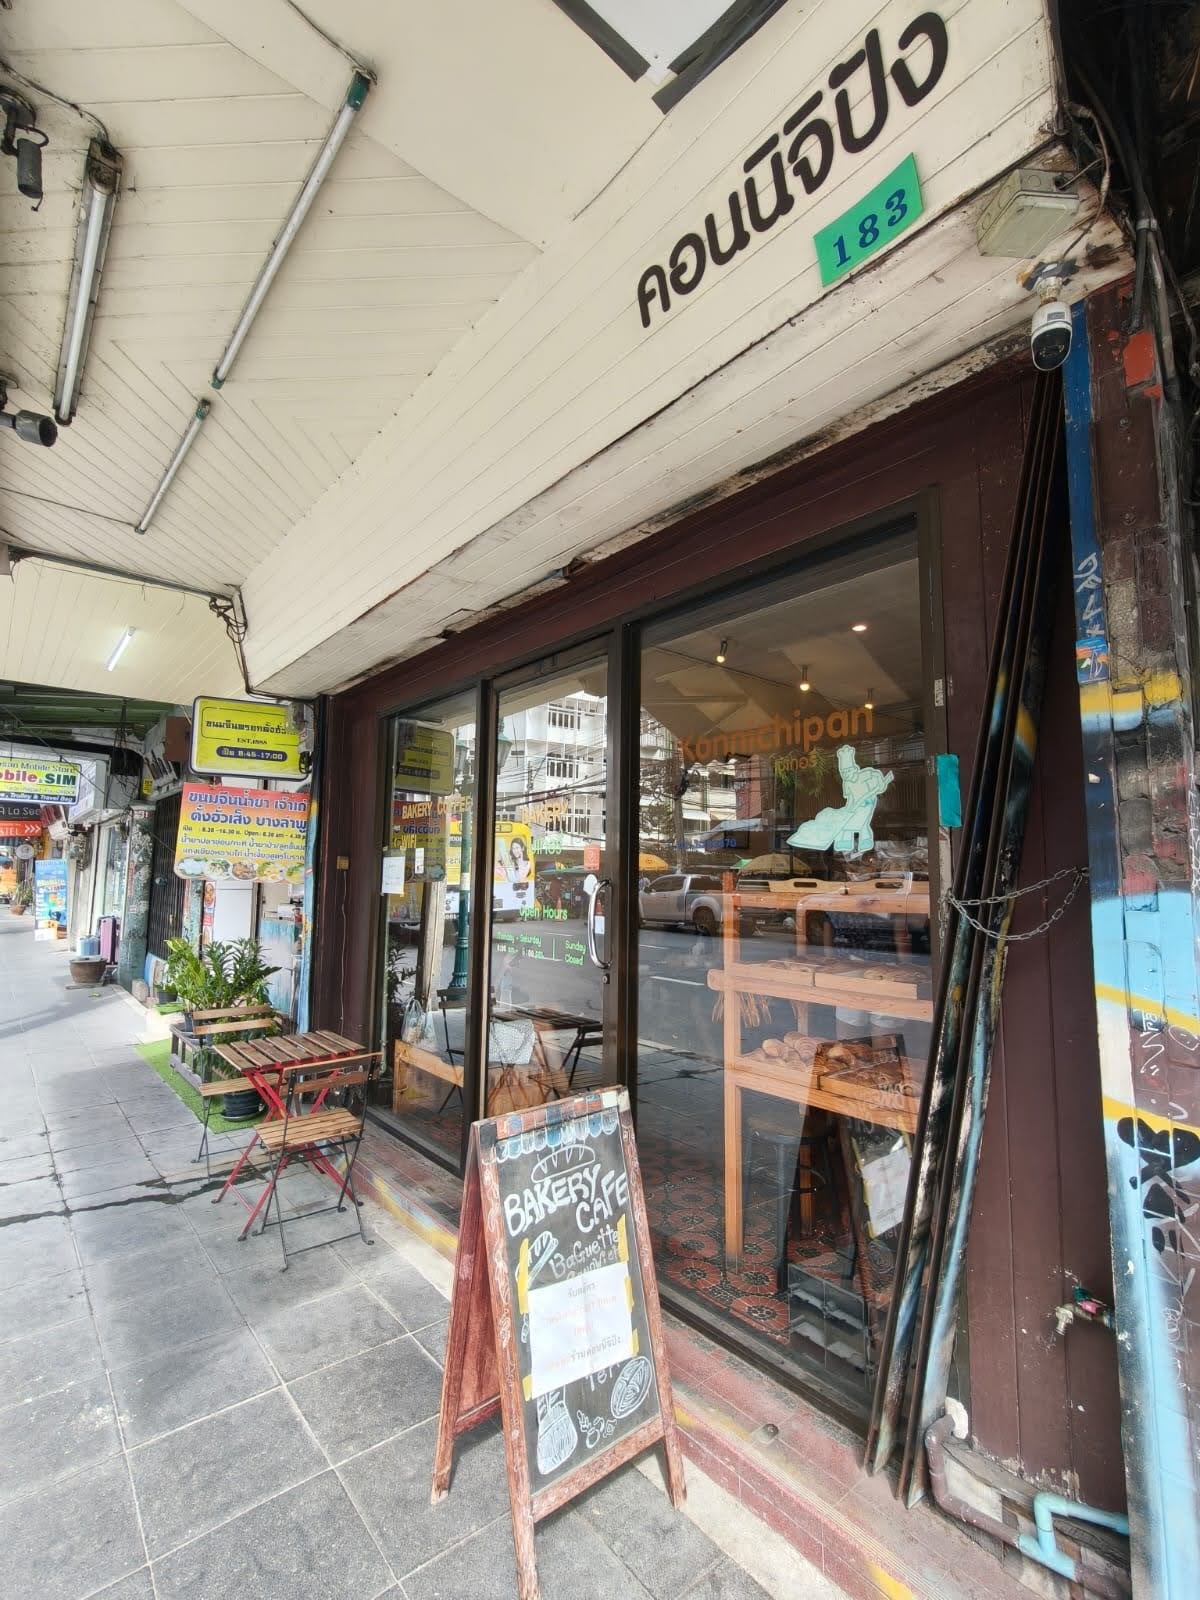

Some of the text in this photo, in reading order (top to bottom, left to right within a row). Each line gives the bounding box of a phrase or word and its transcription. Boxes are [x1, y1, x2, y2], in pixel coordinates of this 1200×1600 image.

[637, 11, 949, 328] คอนนิจิปัง
[832, 188, 908, 268] 183
[44, 773, 77, 786] SIM
[188, 789, 270, 808] ขนมจีนน้ำยา
[190, 804, 251, 825] ตั้งฮั่วเส็ง
[402, 801, 433, 820] BAKERY
[520, 799, 569, 824] BAKERY
[519, 905, 568, 921] Open Hours
[519, 933, 542, 948] Saturday
[565, 939, 586, 954] Sunday
[564, 953, 584, 966] Closed
[503, 1162, 601, 1237] BAKERY
[576, 1171, 629, 1233] CAFE
